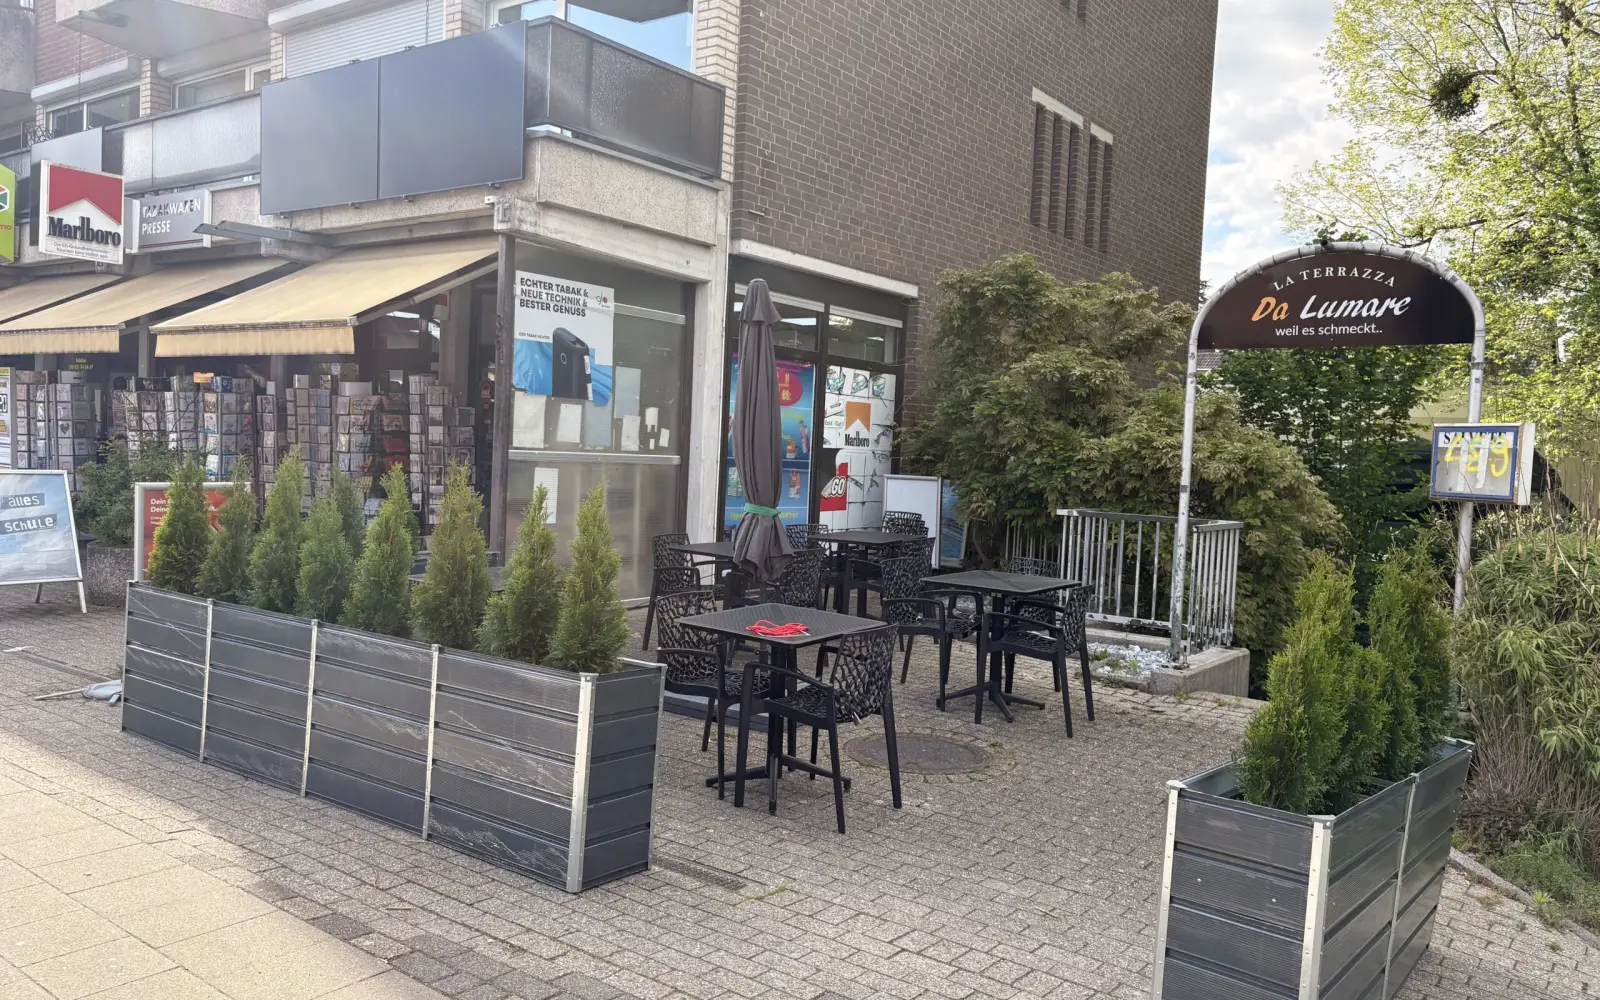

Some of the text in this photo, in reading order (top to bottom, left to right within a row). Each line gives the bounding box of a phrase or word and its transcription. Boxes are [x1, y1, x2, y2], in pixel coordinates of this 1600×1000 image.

[142, 199, 201, 218] TABAKWAREN
[46, 216, 121, 246] Marlboro
[142, 220, 171, 235] PRESSE
[520, 277, 589, 298] ECHTER TABAK &
[1273, 266, 1395, 291] LA TERRAZZA
[520, 288, 543, 300] NEUE
[545, 292, 581, 306] TECHNIK
[582, 299, 588, 308] &
[519, 299, 586, 317] BESTER GENUSS
[1251, 295, 1411, 322] Da Lumare
[1275, 323, 1382, 336] weil es schmeckt..
[844, 431, 870, 447] Marlboro
[831, 478, 845, 496] GO
[8, 495, 40, 507] alles
